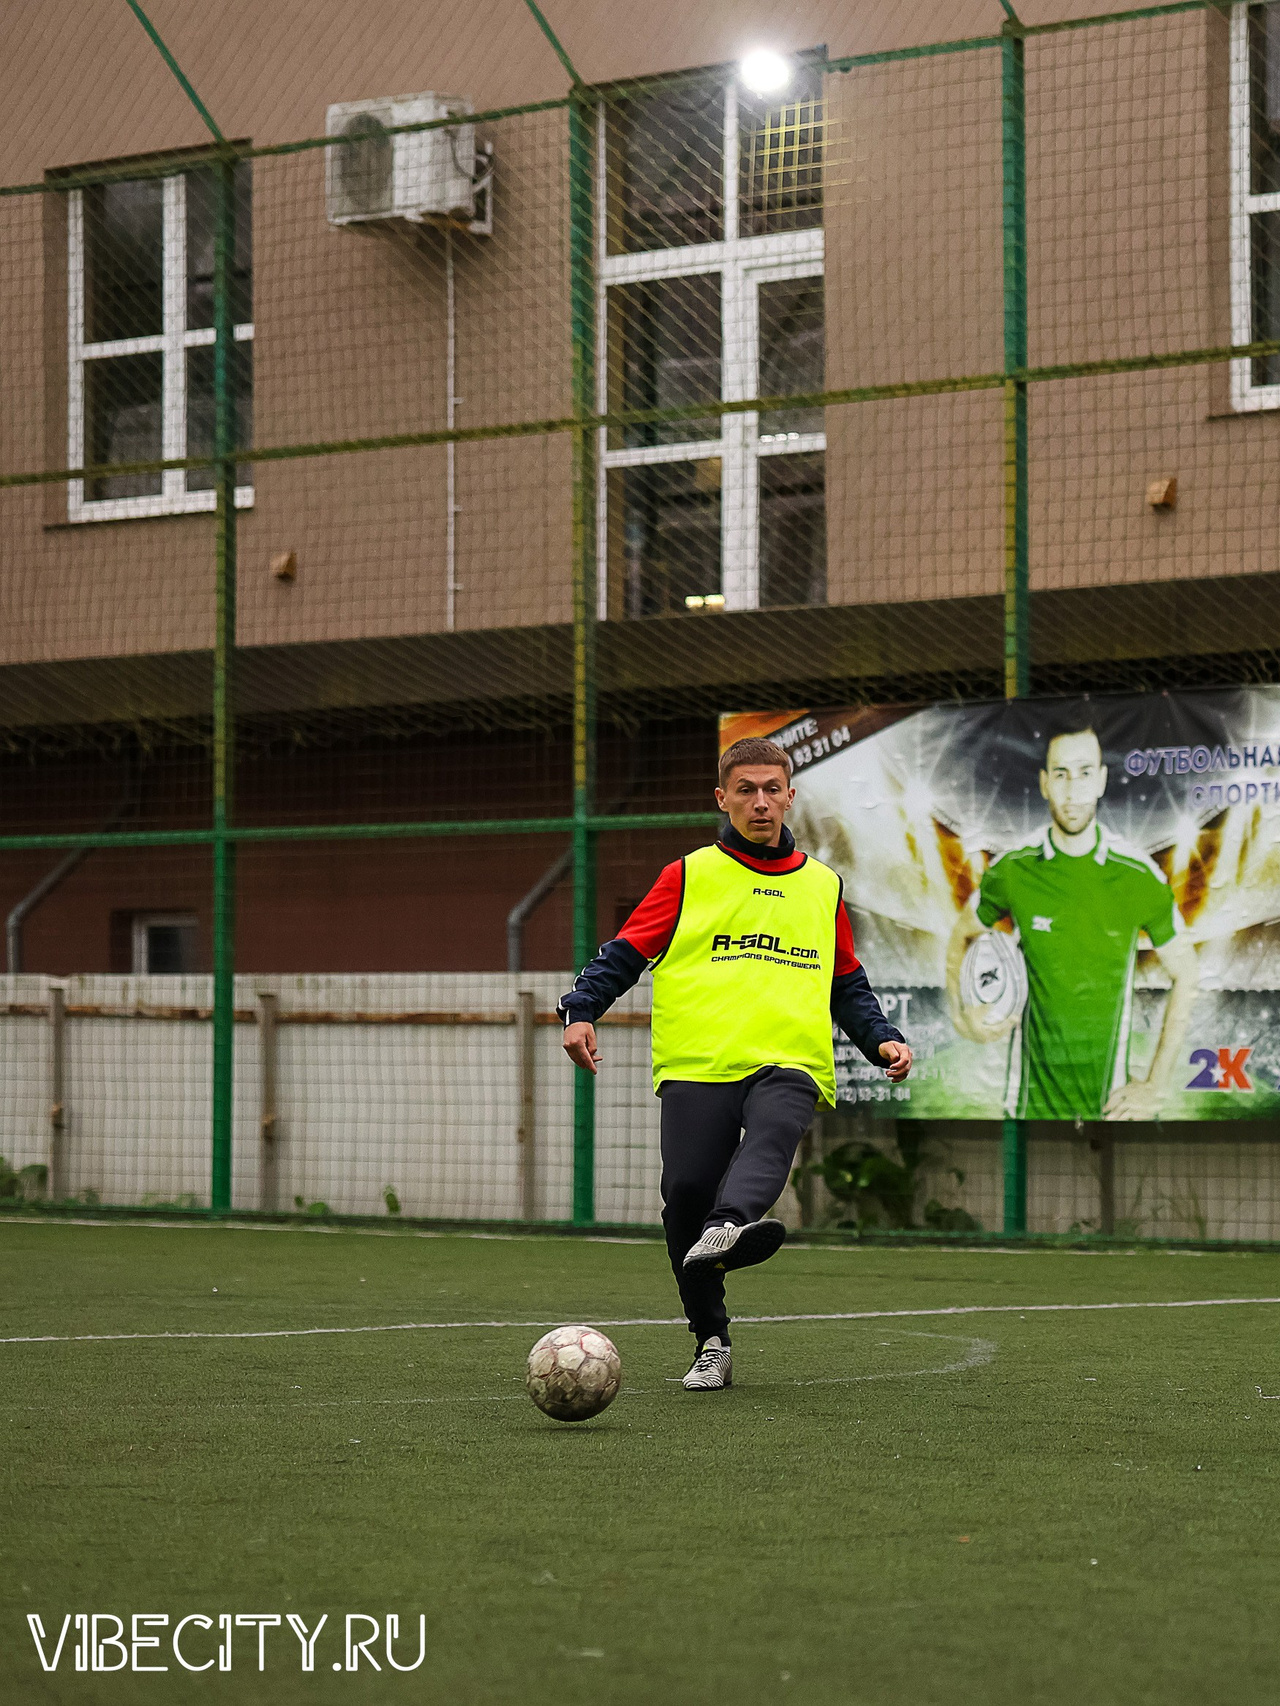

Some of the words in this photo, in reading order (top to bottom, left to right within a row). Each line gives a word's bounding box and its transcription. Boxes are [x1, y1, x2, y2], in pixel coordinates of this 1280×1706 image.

[752, 888, 786, 898] R-GOL
[711, 952, 763, 962] CHAMPIONS
[764, 955, 821, 970] SPORTSWEAR
[1184, 1046, 1253, 1091] 2K
